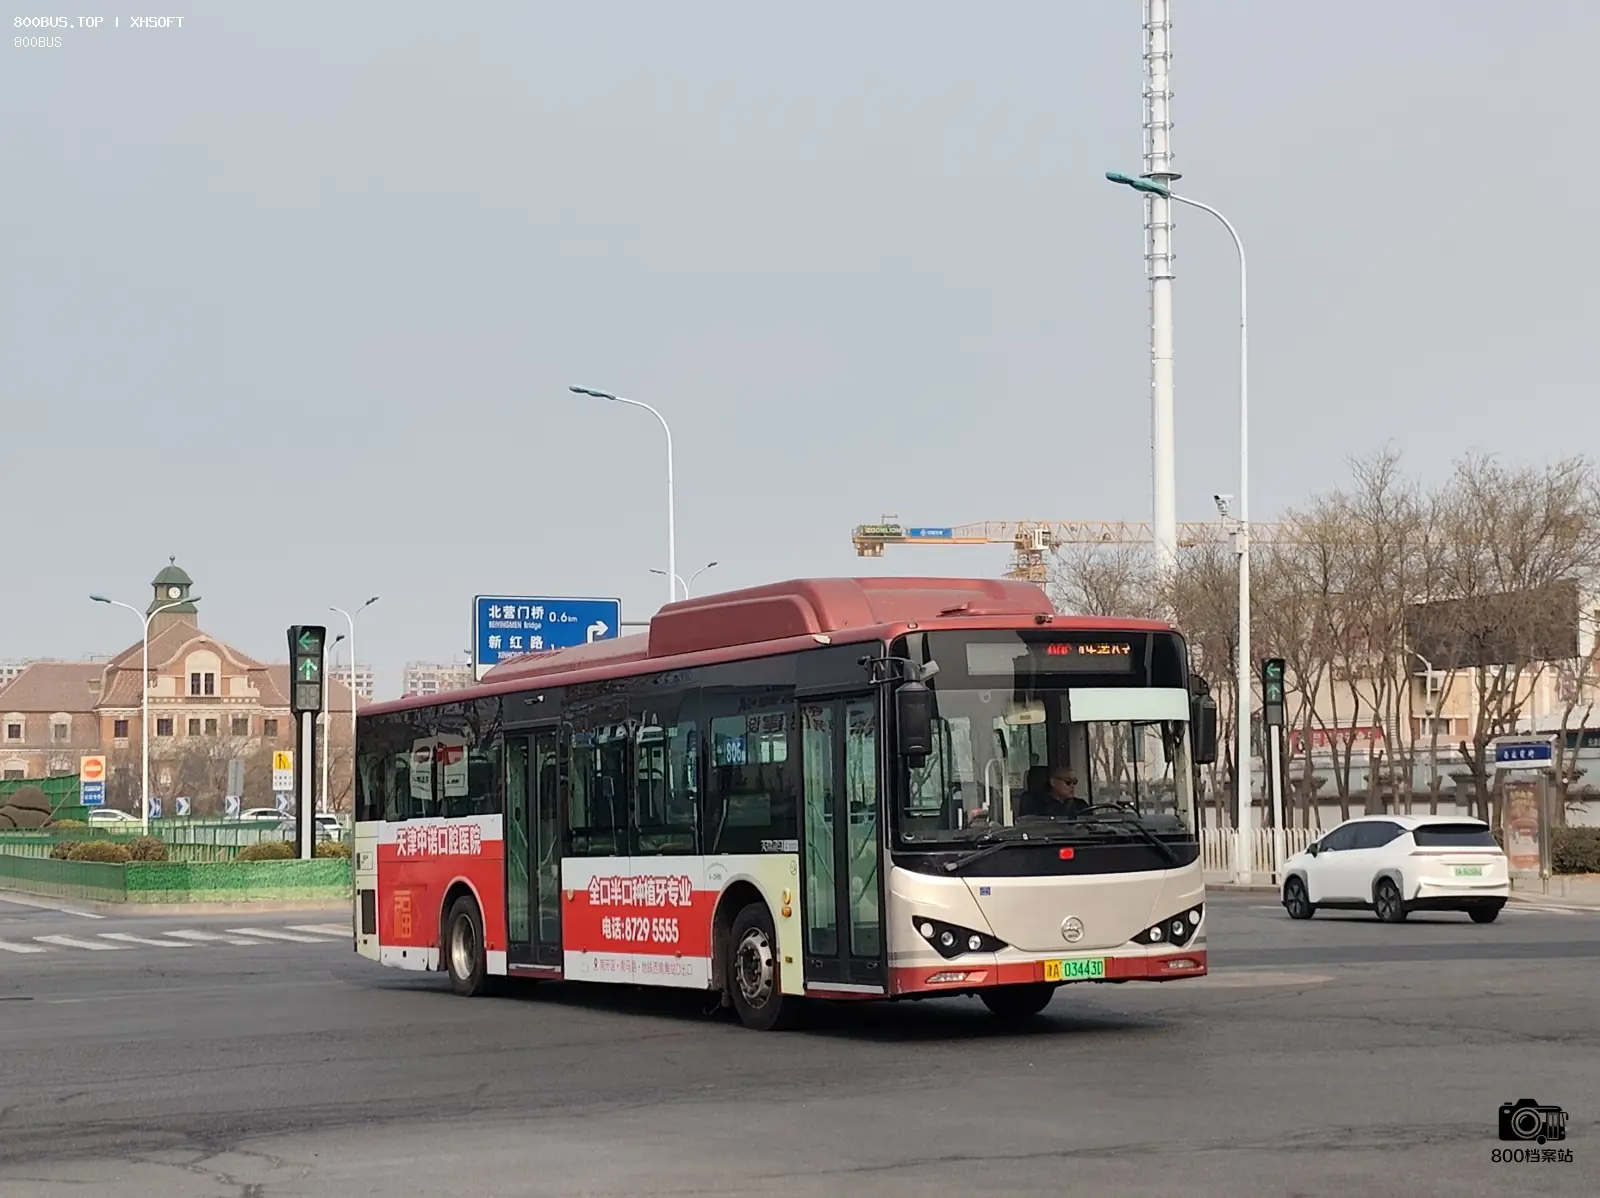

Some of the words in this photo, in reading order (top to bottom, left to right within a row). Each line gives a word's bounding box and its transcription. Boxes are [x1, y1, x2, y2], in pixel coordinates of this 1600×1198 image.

[488, 605, 544, 620] 北营门桥
[524, 622, 542, 631] Bridge
[489, 635, 543, 650] 新红路
[396, 823, 482, 857] 天津中诺口腔医院
[588, 875, 693, 907] 全口半口种植牙专业
[652, 917, 679, 943] 5555
